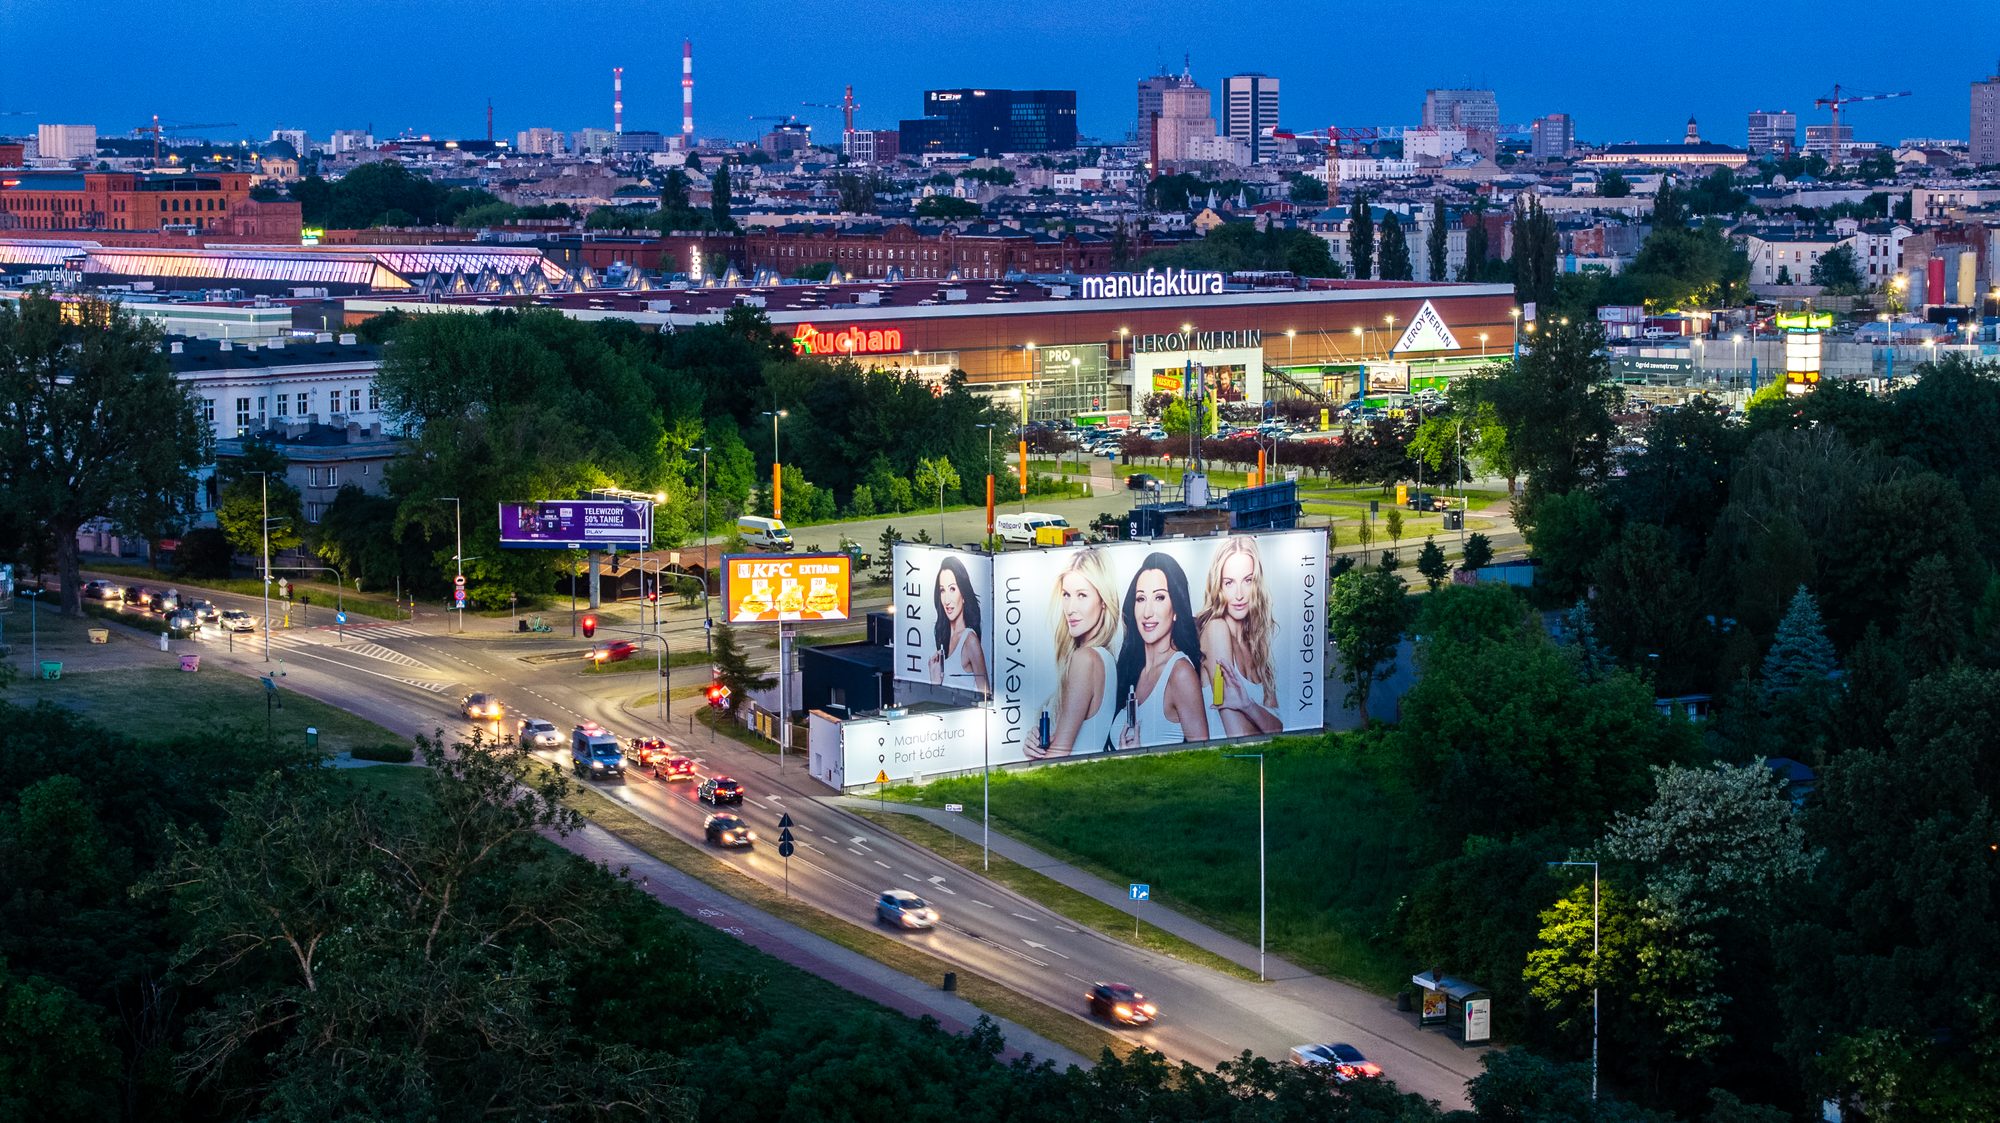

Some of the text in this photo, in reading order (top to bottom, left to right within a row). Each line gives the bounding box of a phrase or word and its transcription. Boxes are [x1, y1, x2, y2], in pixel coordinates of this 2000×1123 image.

[30, 267, 82, 282] manufaktura
[1082, 267, 1223, 298] manufaktura
[792, 323, 902, 355] Auchan
[1133, 329, 1262, 353] LEROY MERLIN
[1403, 315, 1426, 350] LEROY
[1423, 306, 1452, 348] MERLIN
[600, 516, 624, 524] TANIEJ
[752, 563, 792, 578] KFC
[903, 560, 921, 673] HDRÈY
[1299, 555, 1315, 711] You deserve it
[1001, 576, 1025, 744] hdrey.com
[894, 728, 965, 747] Manufaktura
[894, 744, 945, 764] Port Łódź
